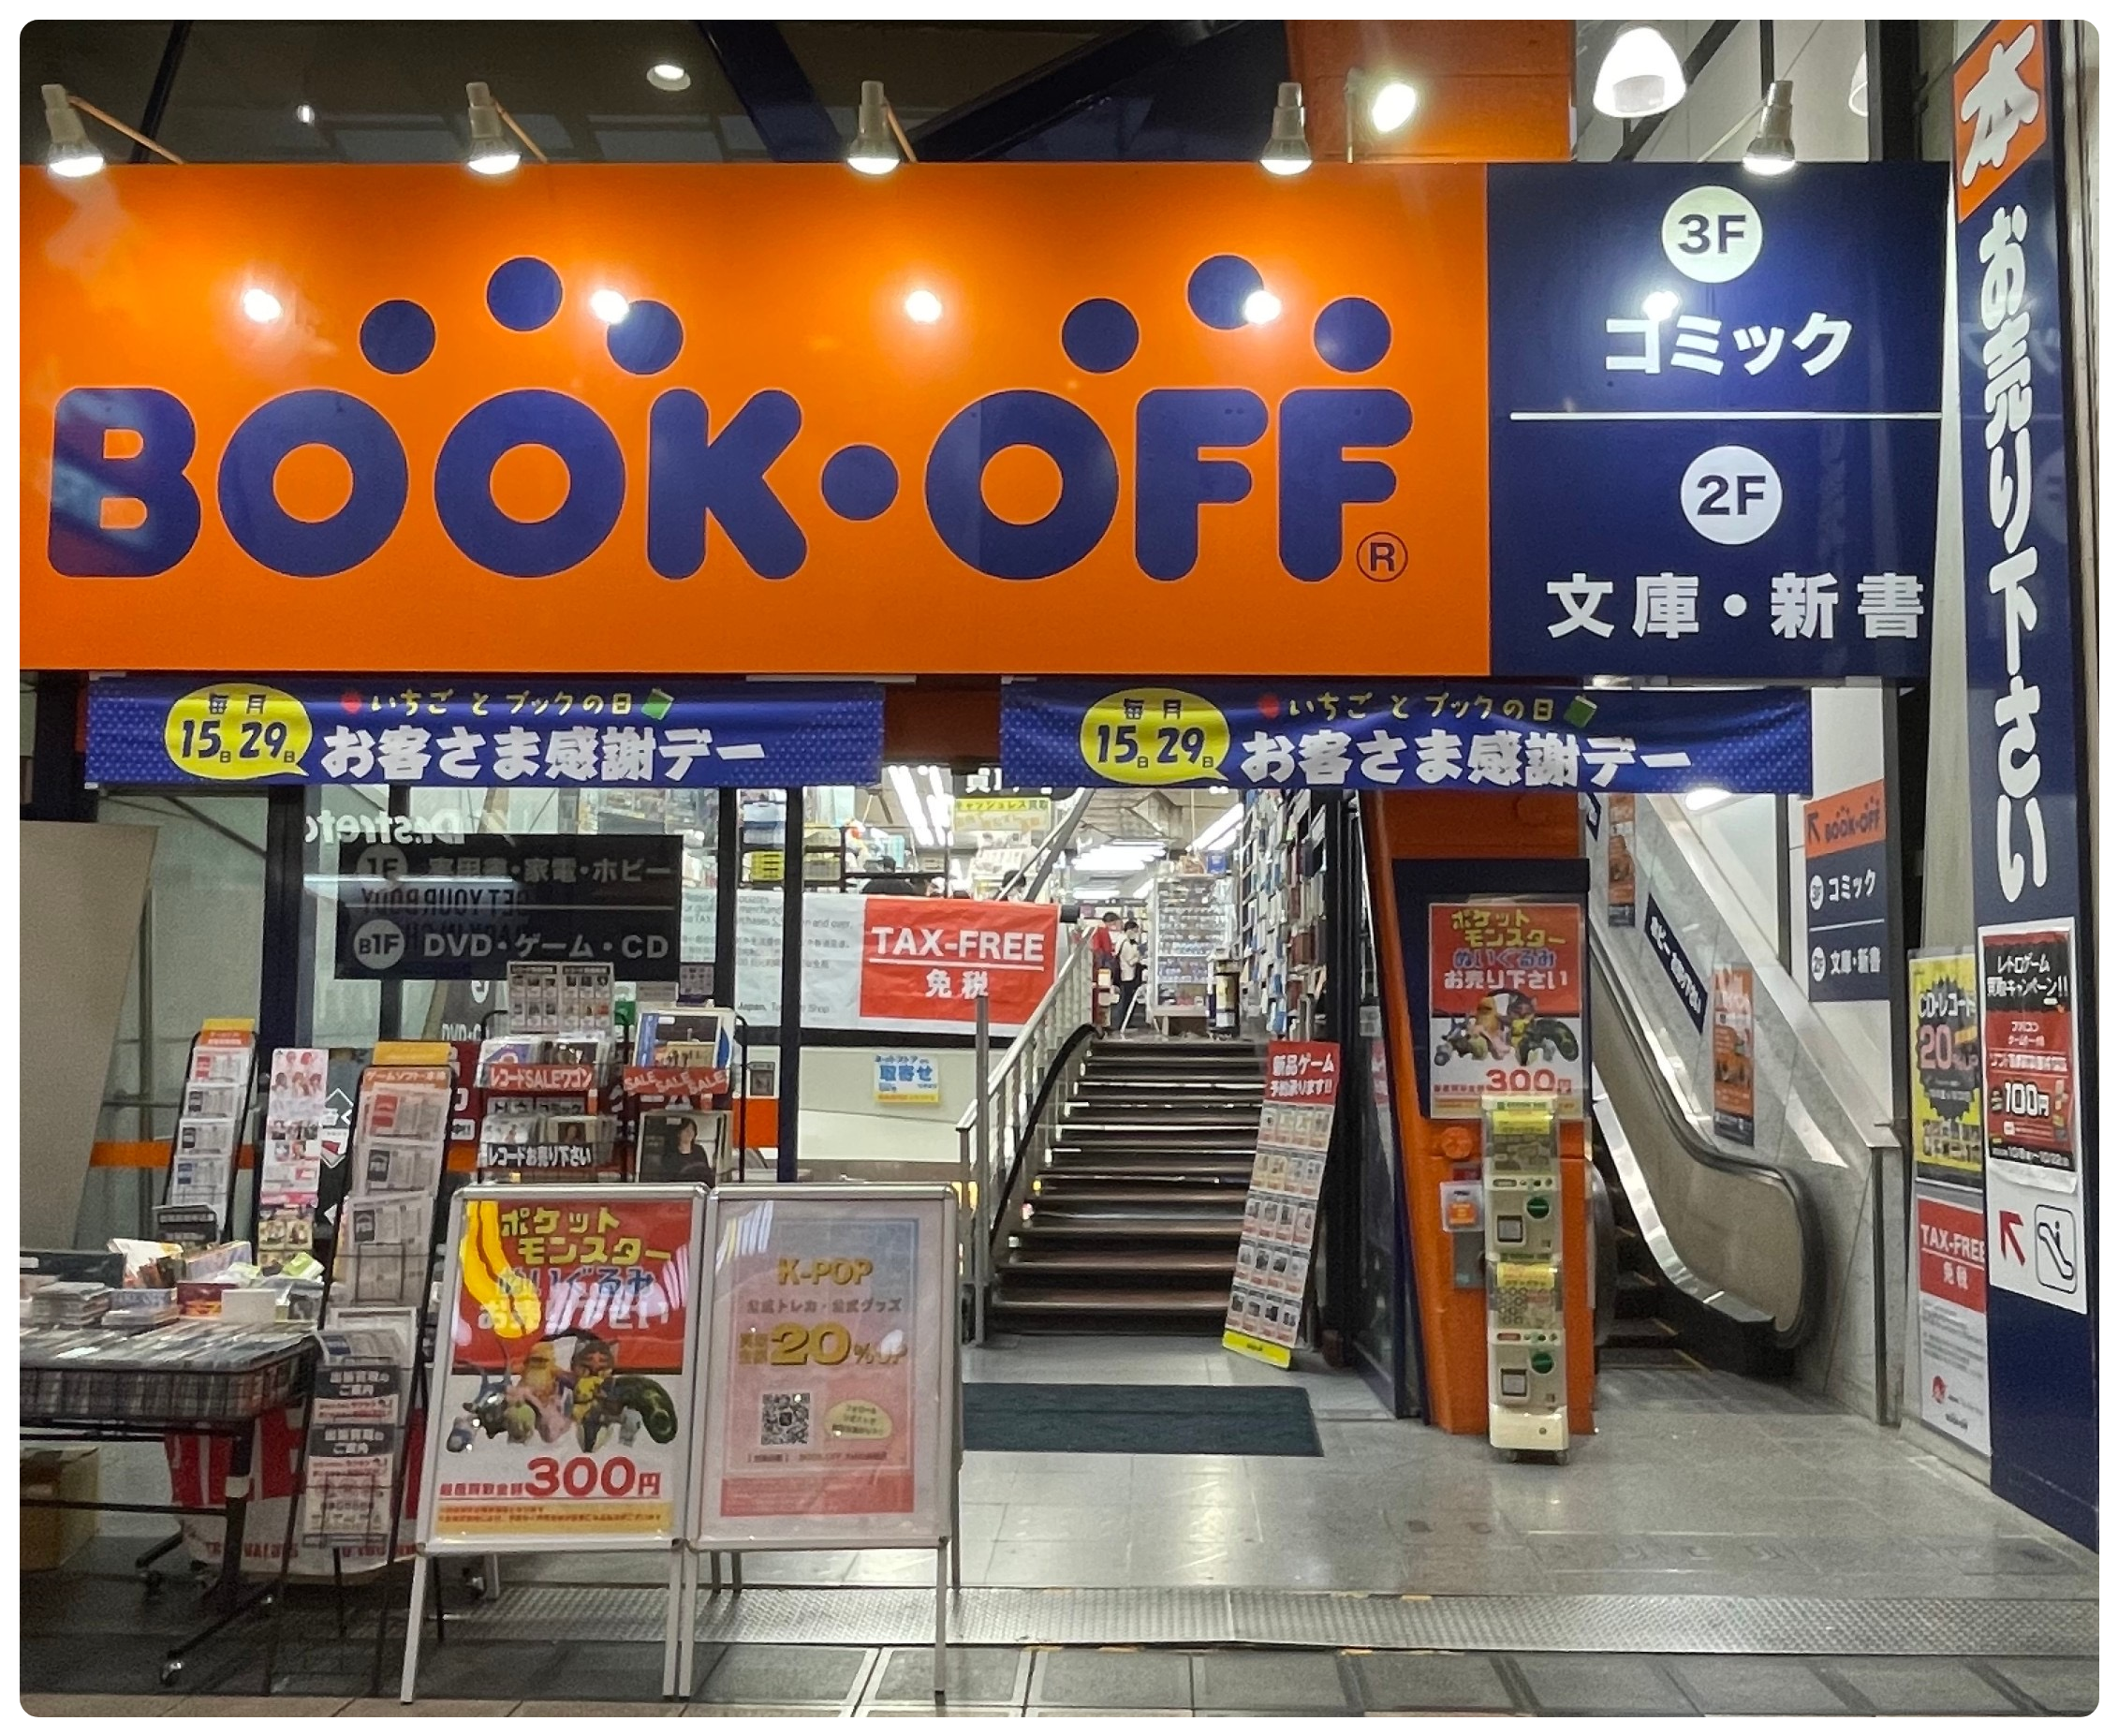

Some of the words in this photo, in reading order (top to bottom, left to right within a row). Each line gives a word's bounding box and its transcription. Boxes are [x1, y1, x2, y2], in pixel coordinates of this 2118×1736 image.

[1960, 24, 2040, 187] 本
[1677, 213, 1746, 255] 3F
[1604, 311, 1853, 376] コミック
[1696, 475, 1767, 516] 2F
[1979, 205, 2048, 903] お売り下さい
[1546, 571, 1925, 640] 文庫・新書
[207, 693, 268, 715] 毎月
[1123, 698, 1183, 720] 毎月
[319, 725, 766, 782] お客さま感謝デー
[1241, 728, 1692, 787] お客さま感謝デー
[1828, 868, 1876, 903] コミック
[1451, 908, 1531, 930] ポケット
[423, 932, 669, 960] DVD・ゲーム・CD
[871, 926, 1045, 963] TAX-FREE
[1463, 928, 1566, 949] モンスター
[925, 968, 989, 1000] 免税
[1444, 969, 1568, 991] お売り下さい
[624, 1070, 656, 1091] SALE
[655, 1072, 691, 1094] SALE
[688, 1069, 728, 1095] SALE
[2004, 1081, 2050, 1117] 100円
[500, 1206, 620, 1237] ポケット
[517, 1235, 672, 1265] モンスター
[1919, 1224, 1986, 1264] TAX-FREE
[777, 1257, 874, 1287] K-POP
[525, 1456, 662, 1497] 300円
